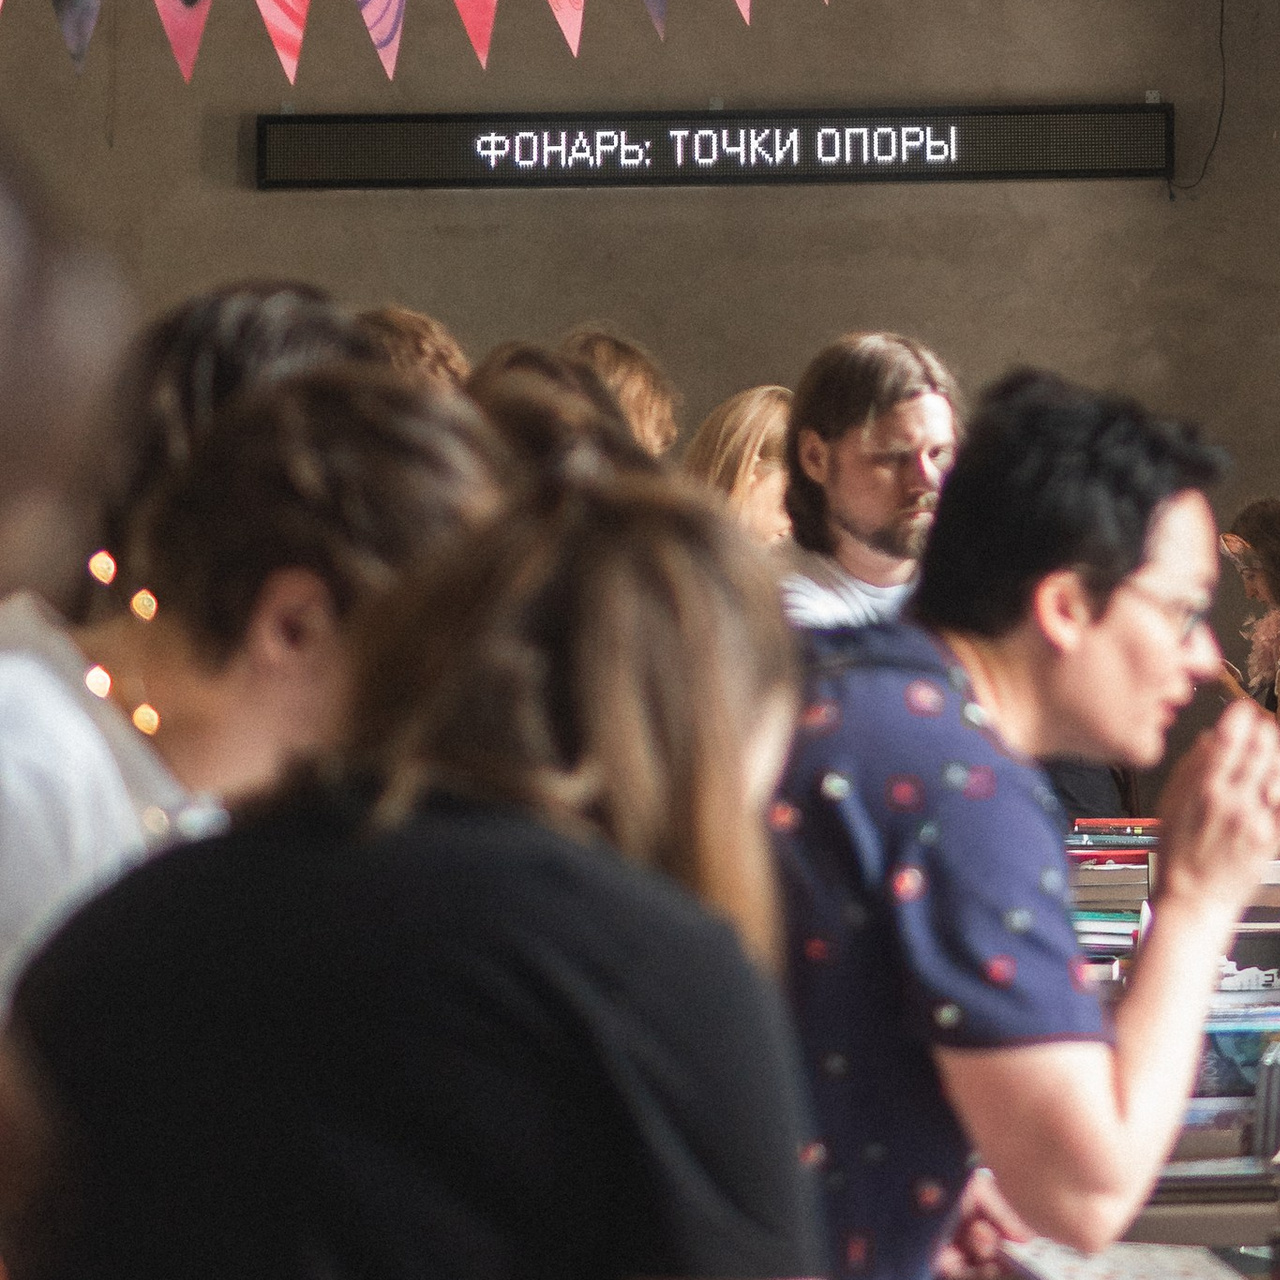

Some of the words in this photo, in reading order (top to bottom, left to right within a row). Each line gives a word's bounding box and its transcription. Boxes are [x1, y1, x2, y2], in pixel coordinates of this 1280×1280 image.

[476, 130, 652, 169] ФОНАРЬ:
[669, 128, 800, 167] ТОЧКИ
[816, 125, 958, 166] ОПОРЫ
